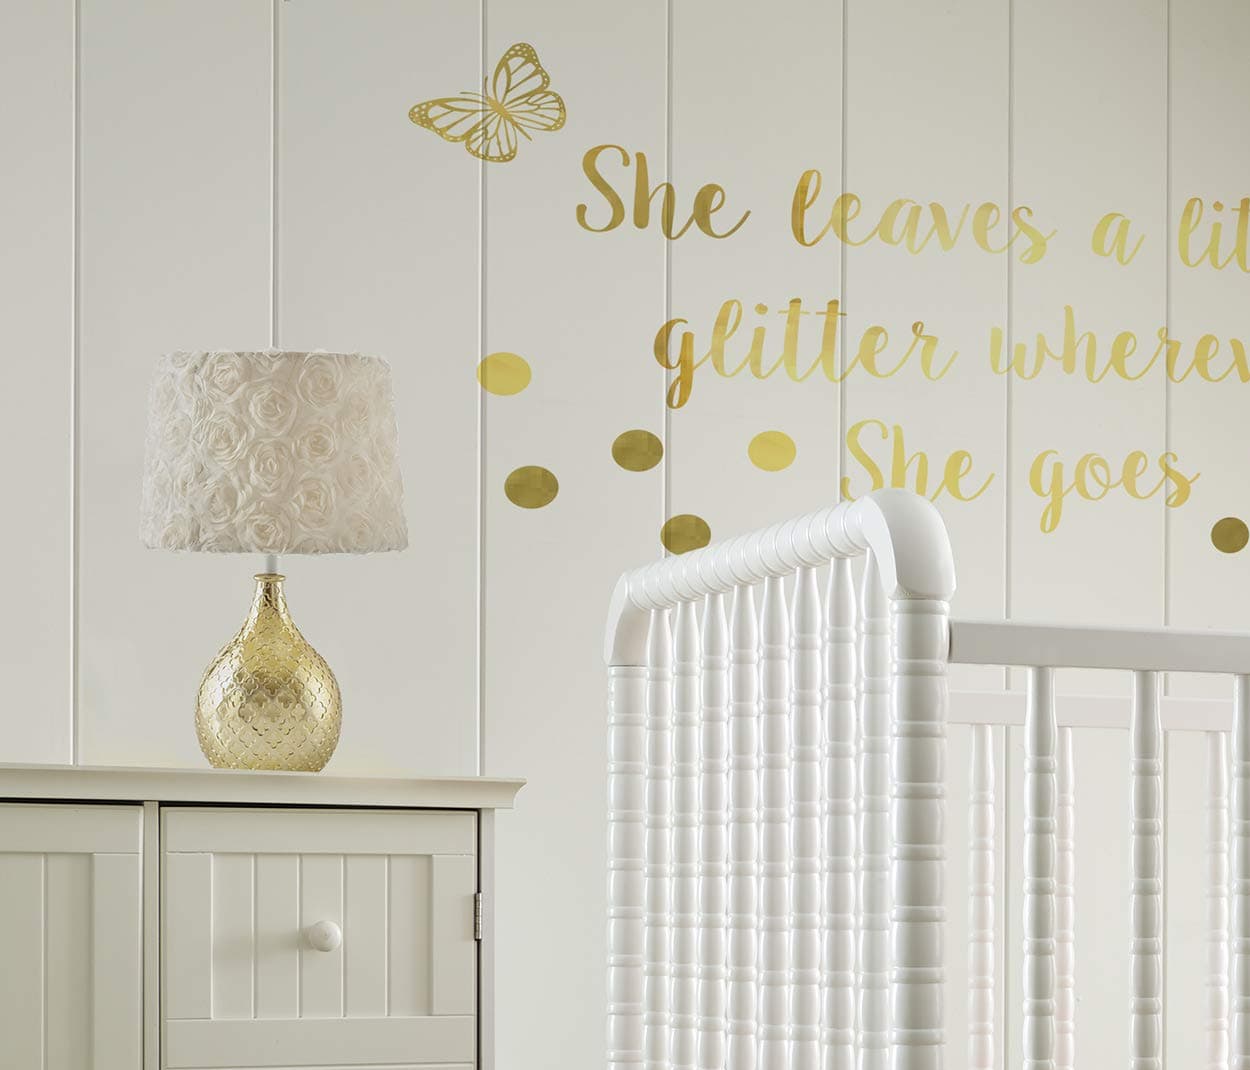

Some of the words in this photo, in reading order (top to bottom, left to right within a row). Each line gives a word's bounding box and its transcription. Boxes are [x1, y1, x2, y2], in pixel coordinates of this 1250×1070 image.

[576, 144, 750, 240] She
[791, 168, 1057, 265] leaves
[1091, 212, 1146, 266] a
[653, 297, 959, 410] glitter
[840, 419, 995, 503] She
[1028, 449, 1201, 535] goes
